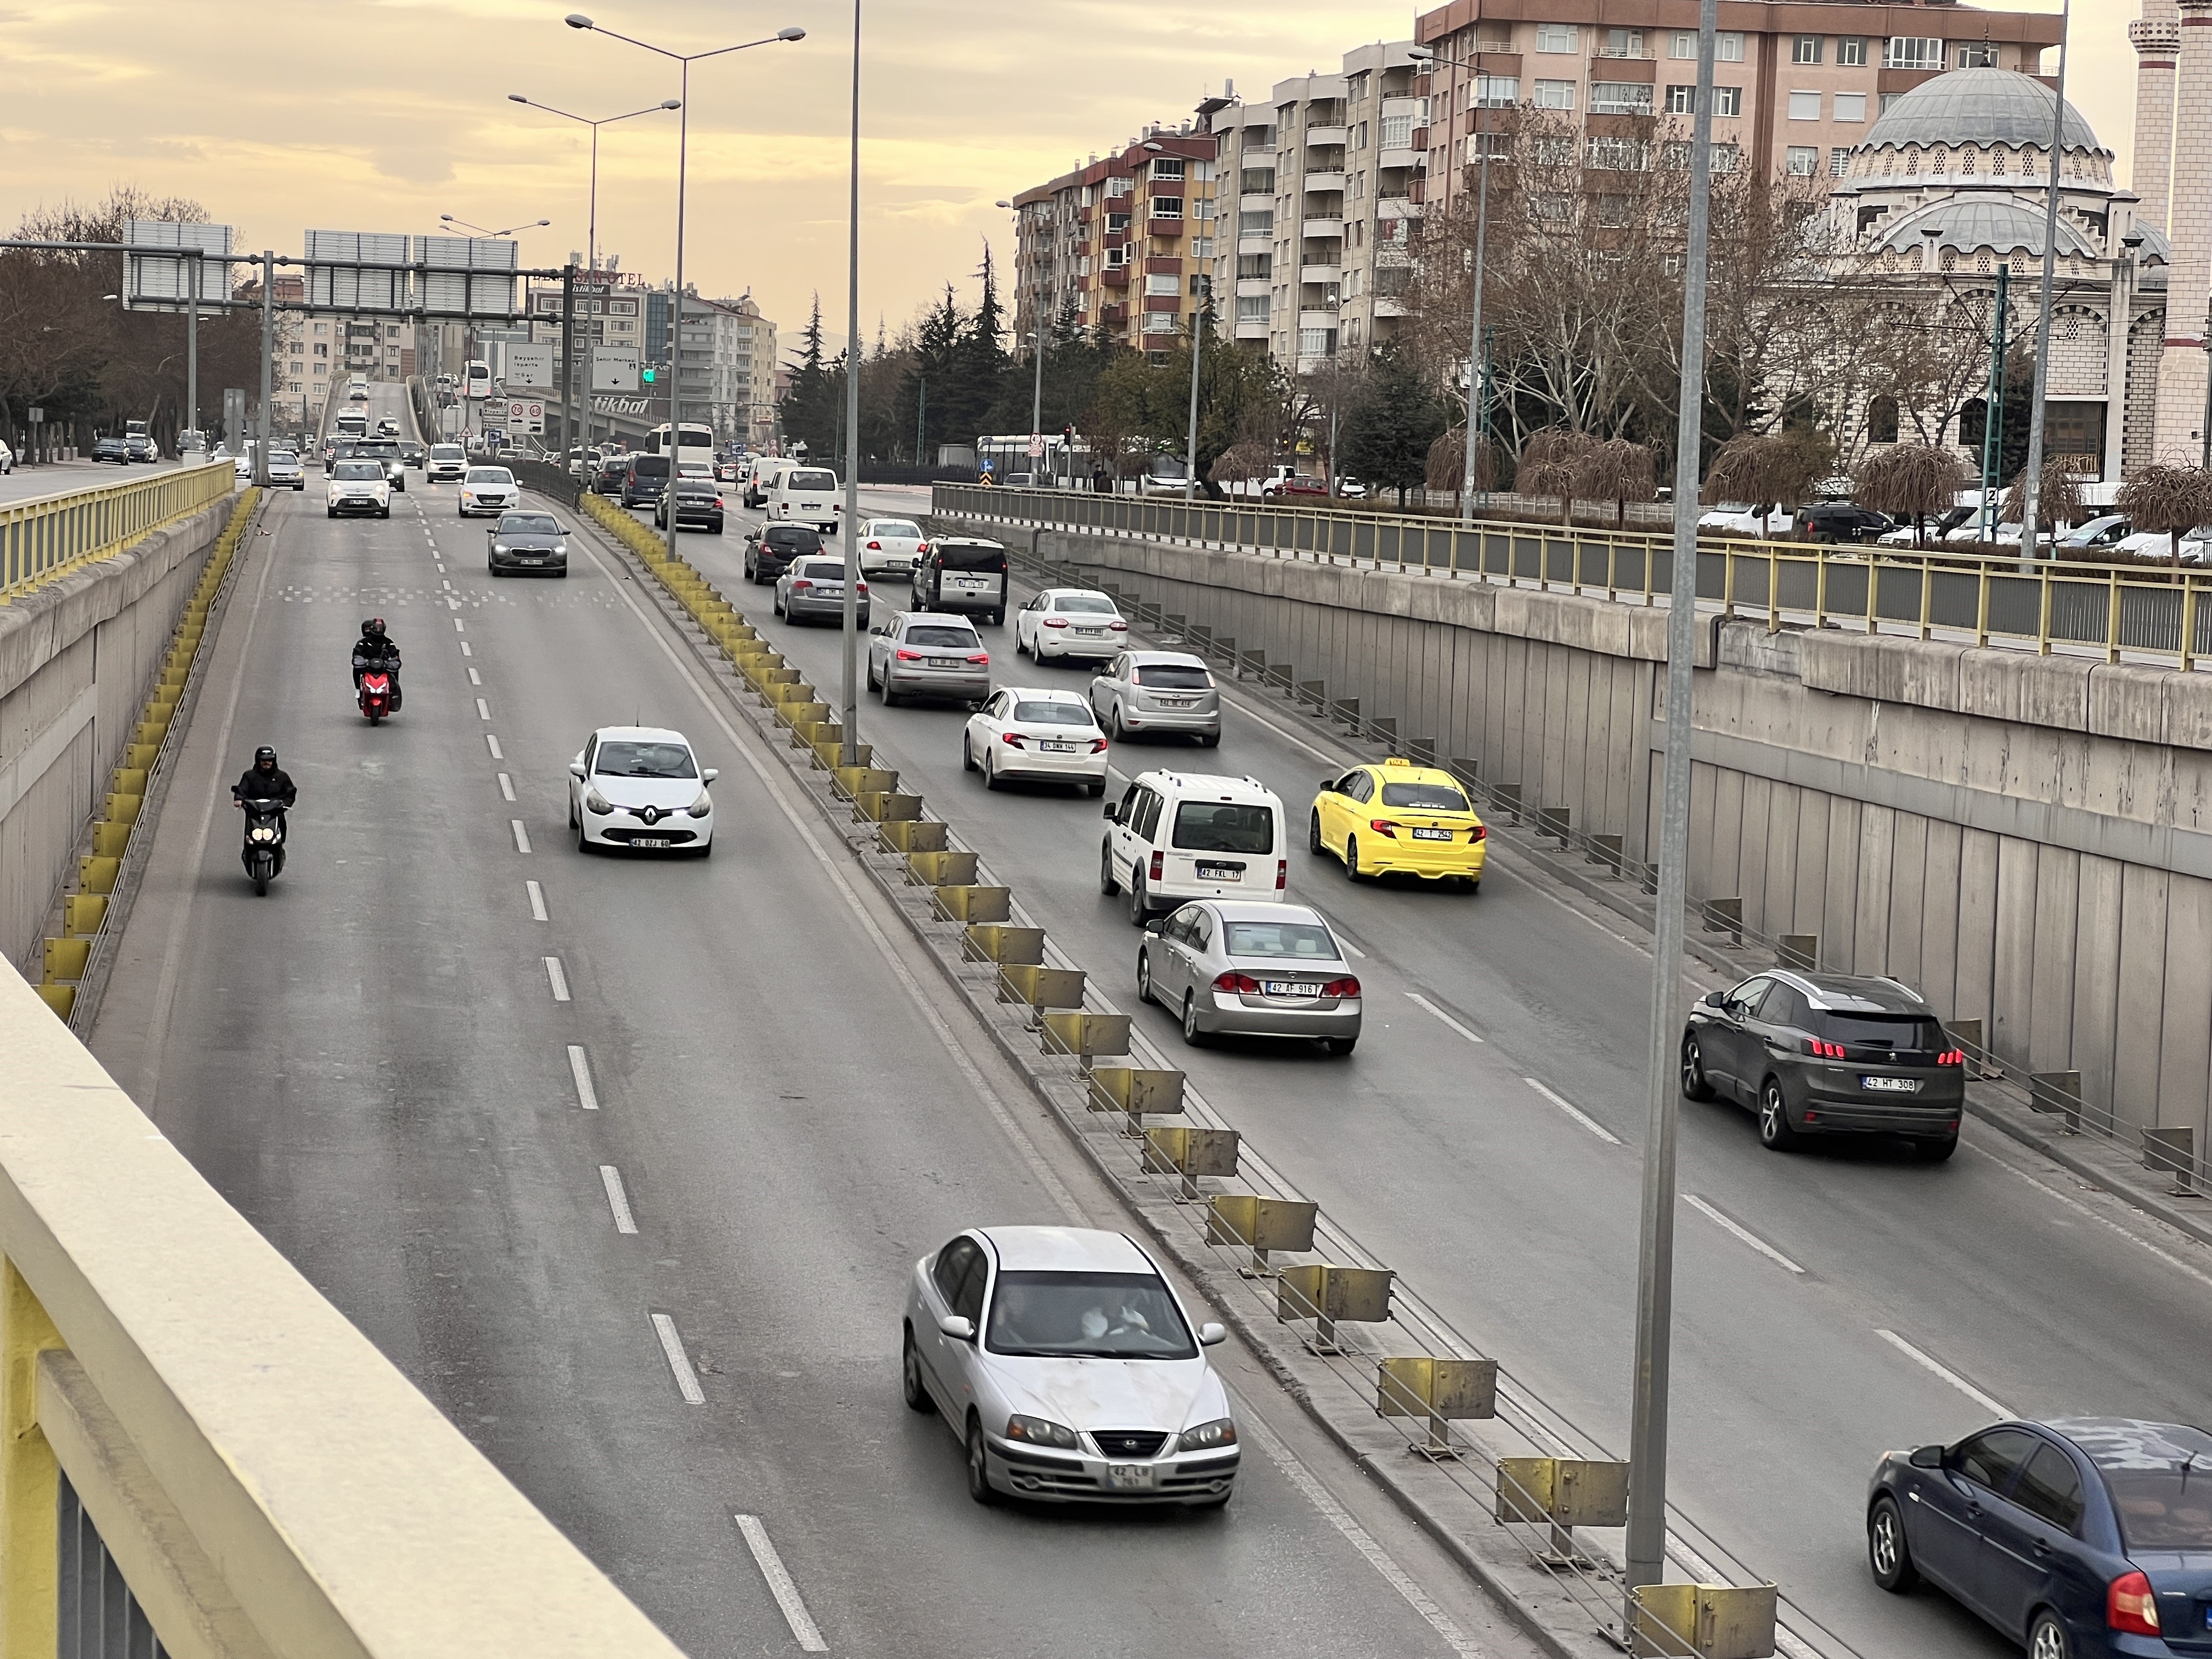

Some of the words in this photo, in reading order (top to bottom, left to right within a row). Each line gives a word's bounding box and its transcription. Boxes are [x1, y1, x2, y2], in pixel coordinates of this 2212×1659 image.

[1989, 490, 1995, 501] 2
[1202, 868, 1210, 877] 42
[1215, 870, 1227, 878] FKL
[1272, 983, 1282, 992] 42
[1286, 984, 1295, 993] AF
[1299, 985, 1313, 994] 916
[1867, 1077, 1878, 1087] 42
[1882, 1079, 1893, 1088] HT
[1898, 1080, 1914, 1090] 308
[1114, 1466, 1126, 1476] 42
